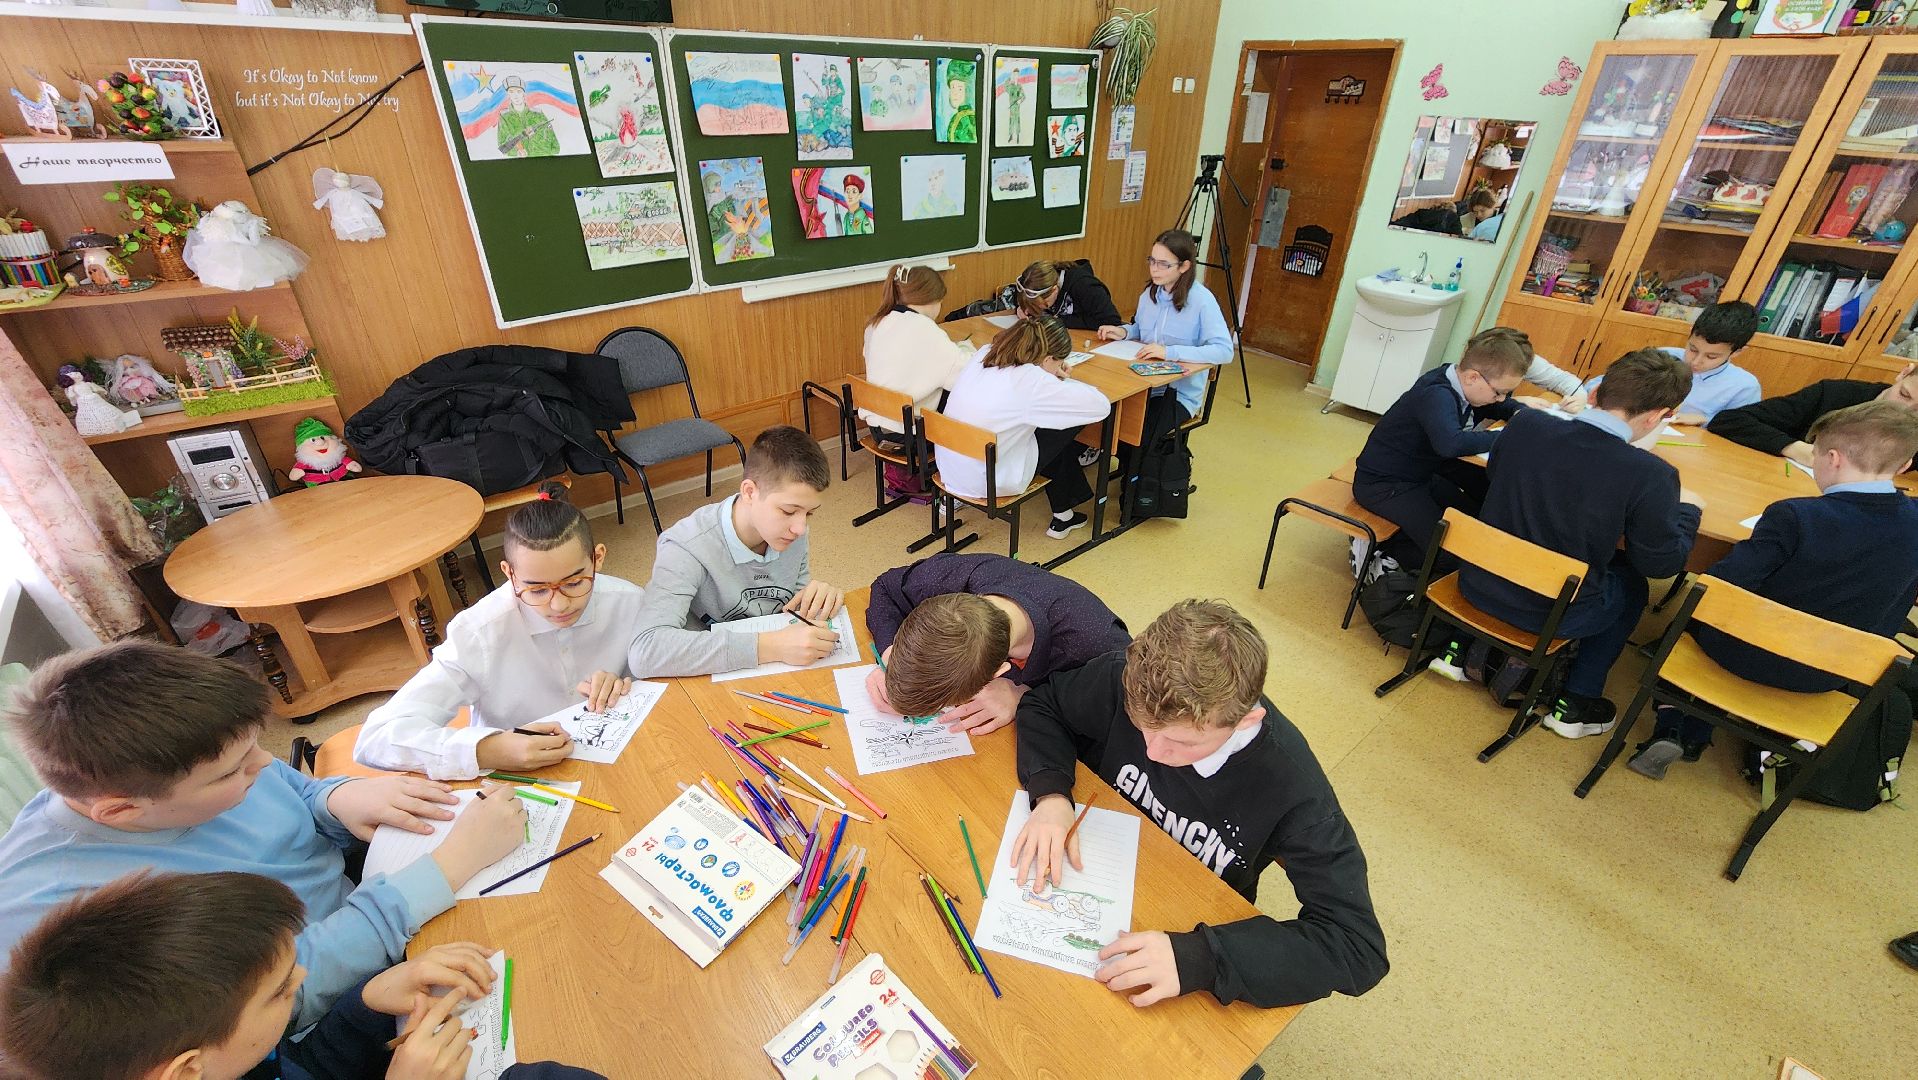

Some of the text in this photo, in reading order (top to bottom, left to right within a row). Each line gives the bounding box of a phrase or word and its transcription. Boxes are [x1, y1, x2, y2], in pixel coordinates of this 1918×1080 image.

[243, 67, 378, 90] It's Okay to Not know
[235, 91, 258, 107] but
[260, 92, 278, 107] it's
[281, 93, 306, 107] Not
[308, 90, 342, 113] Okay
[344, 94, 355, 107] to
[383, 94, 400, 112] try
[19, 156, 162, 169] Наше творчество
[641, 840, 656, 852] 24
[879, 988, 897, 1005] 24
[791, 1026, 822, 1057] BRAUBERG
